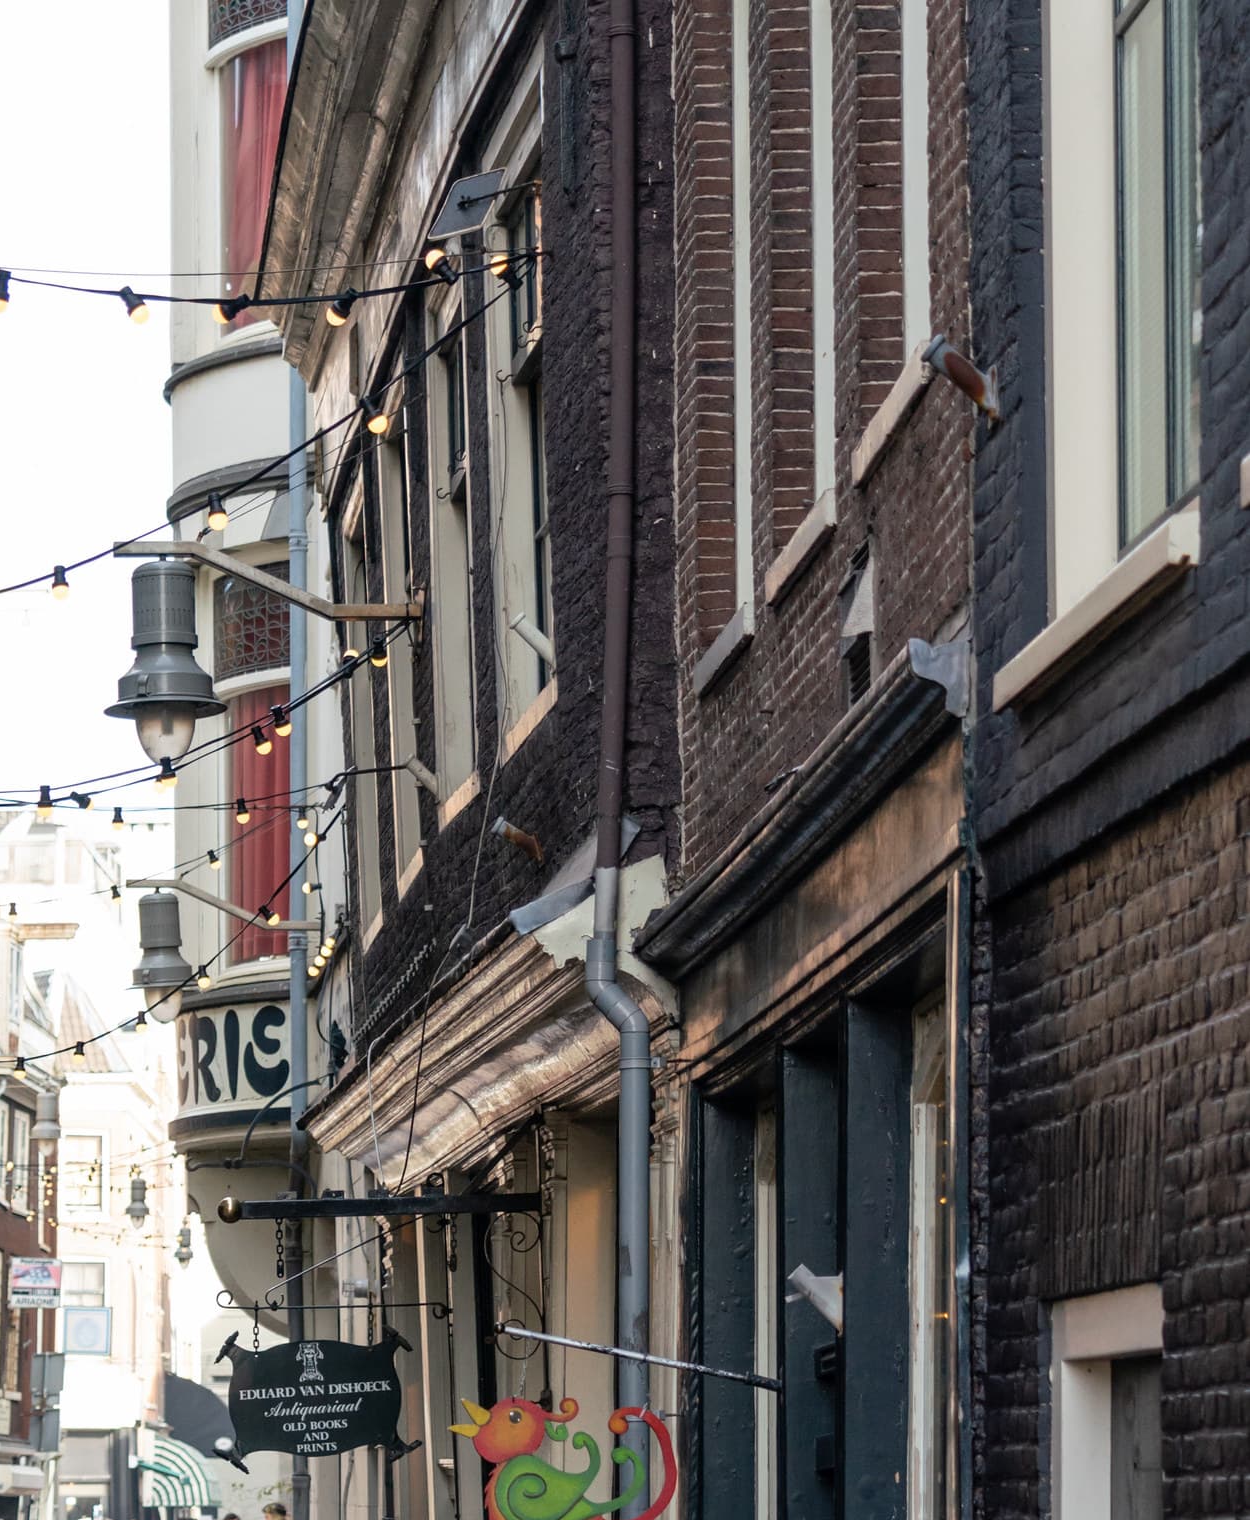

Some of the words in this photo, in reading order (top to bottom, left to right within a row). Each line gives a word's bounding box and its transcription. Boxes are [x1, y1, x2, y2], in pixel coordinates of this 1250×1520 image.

[239, 1387, 296, 1401] EDUARD
[299, 1385, 325, 1396] VAN
[328, 1380, 392, 1395] DISHOECK
[264, 1397, 363, 1421] Antiquariaat
[283, 1421, 307, 1432] OLD
[310, 1418, 348, 1431] BOOKS
[303, 1431, 329, 1442] AND
[296, 1442, 338, 1453] PRINTS
